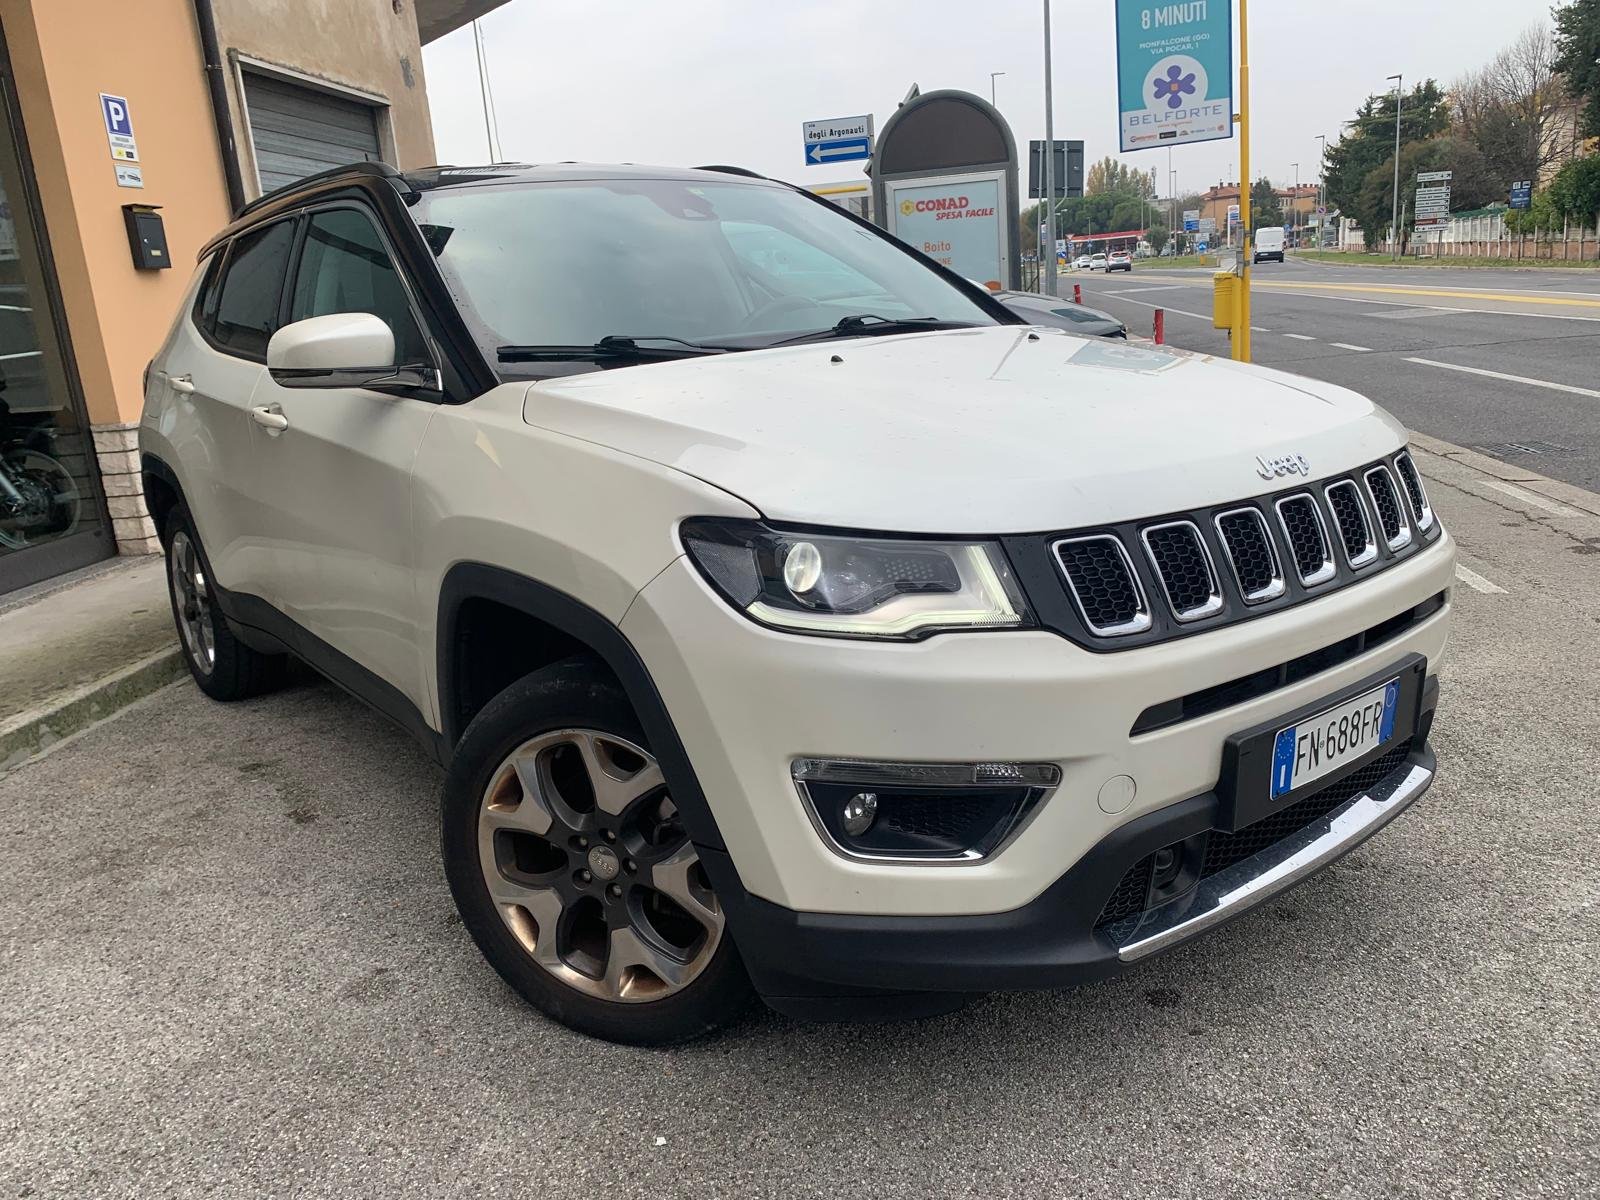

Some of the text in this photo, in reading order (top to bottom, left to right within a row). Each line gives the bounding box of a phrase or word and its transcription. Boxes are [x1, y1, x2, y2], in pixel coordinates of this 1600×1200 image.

[1141, 1, 1207, 29] 8 MINUTI
[1140, 33, 1210, 49] MONFALCONE (GO)
[1150, 47, 1163, 55] VIA
[108, 101, 125, 130] P
[1129, 104, 1222, 126] BELFORTE
[808, 125, 864, 140] degli Argonauti
[915, 196, 969, 213] CONAD
[936, 208, 994, 220] SPESA FACILE
[924, 241, 951, 253] Boito
[1256, 453, 1310, 480] Jeep
